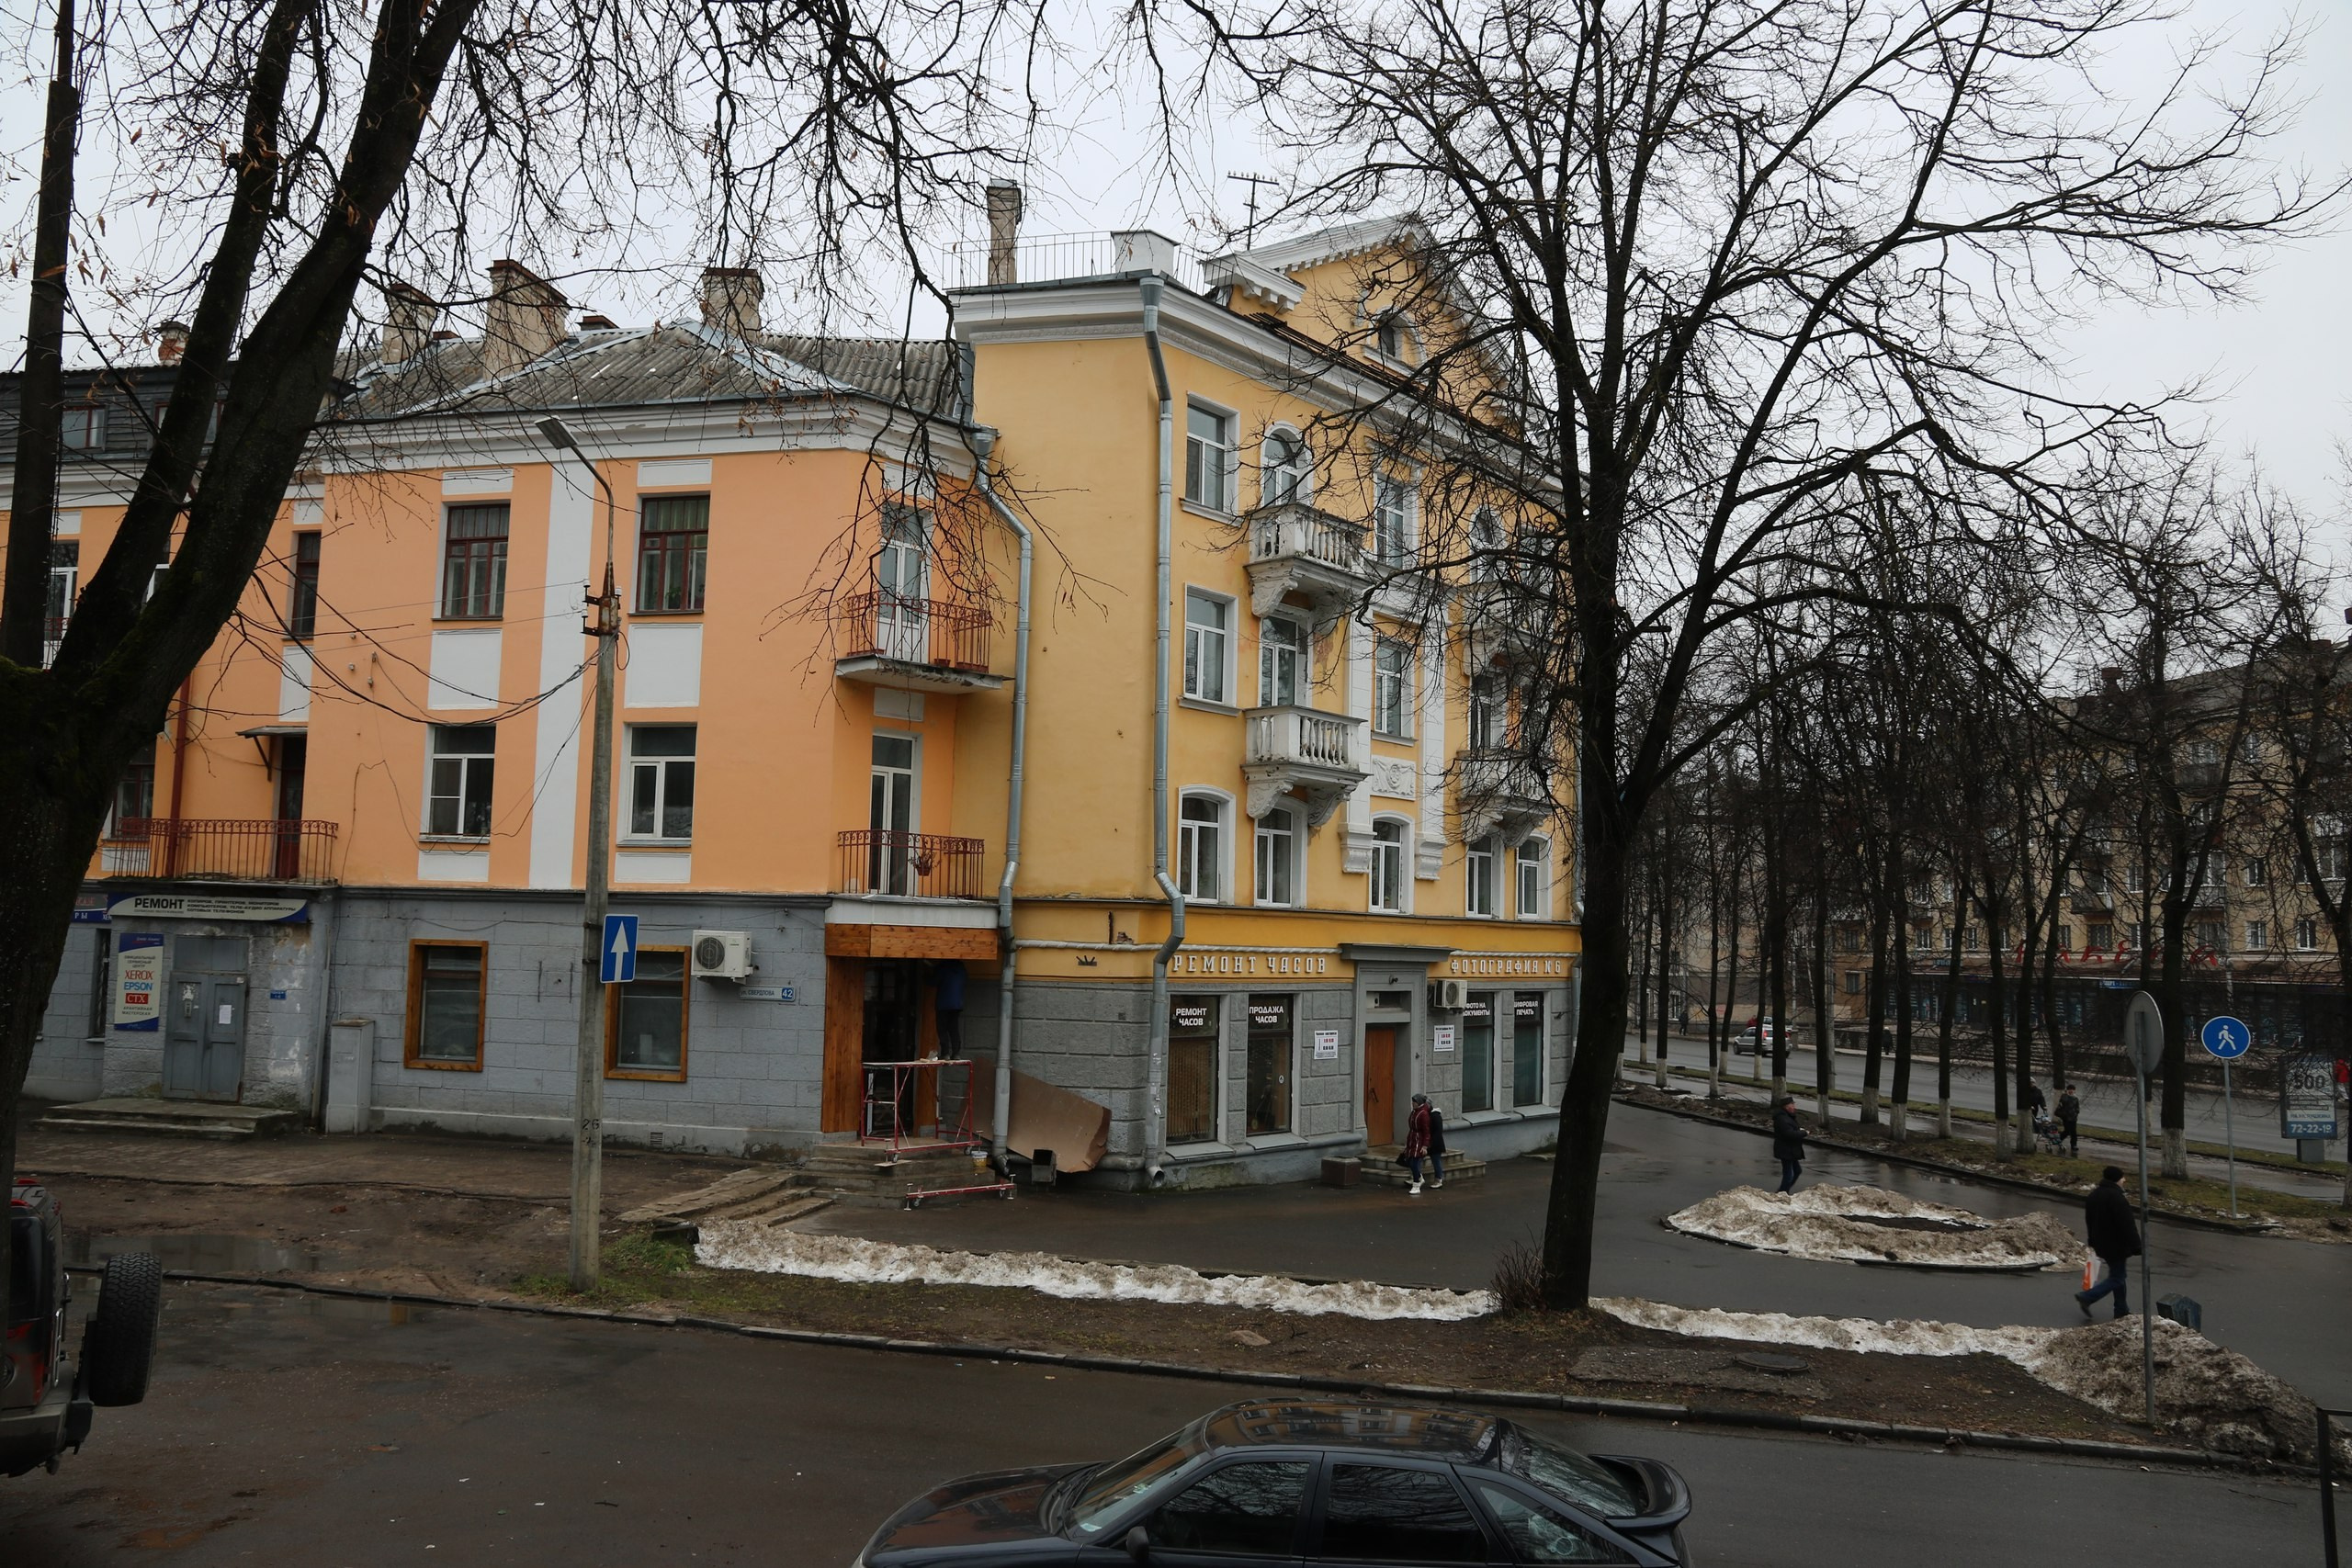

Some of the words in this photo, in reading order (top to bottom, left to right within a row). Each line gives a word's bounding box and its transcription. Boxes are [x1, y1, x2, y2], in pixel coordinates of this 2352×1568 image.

[134, 897, 185, 909] РЕМОНТ
[1172, 954, 1257, 973] РЕМОНТ
[1267, 956, 1326, 974] ЧАСОВ
[1451, 959, 1539, 974] ФОТОГРАФИЯ
[124, 970, 154, 980] XEROX
[124, 982, 153, 991] EPSON
[782, 989, 793, 998] 42
[127, 994, 146, 1003] CTX
[1175, 1008, 1207, 1017] РЕМОНТ
[1249, 1005, 1284, 1015] ПРОДАЖА
[1178, 1017, 1204, 1026] ЧАСОВ
[1255, 1015, 1278, 1023] ЧАСОВ
